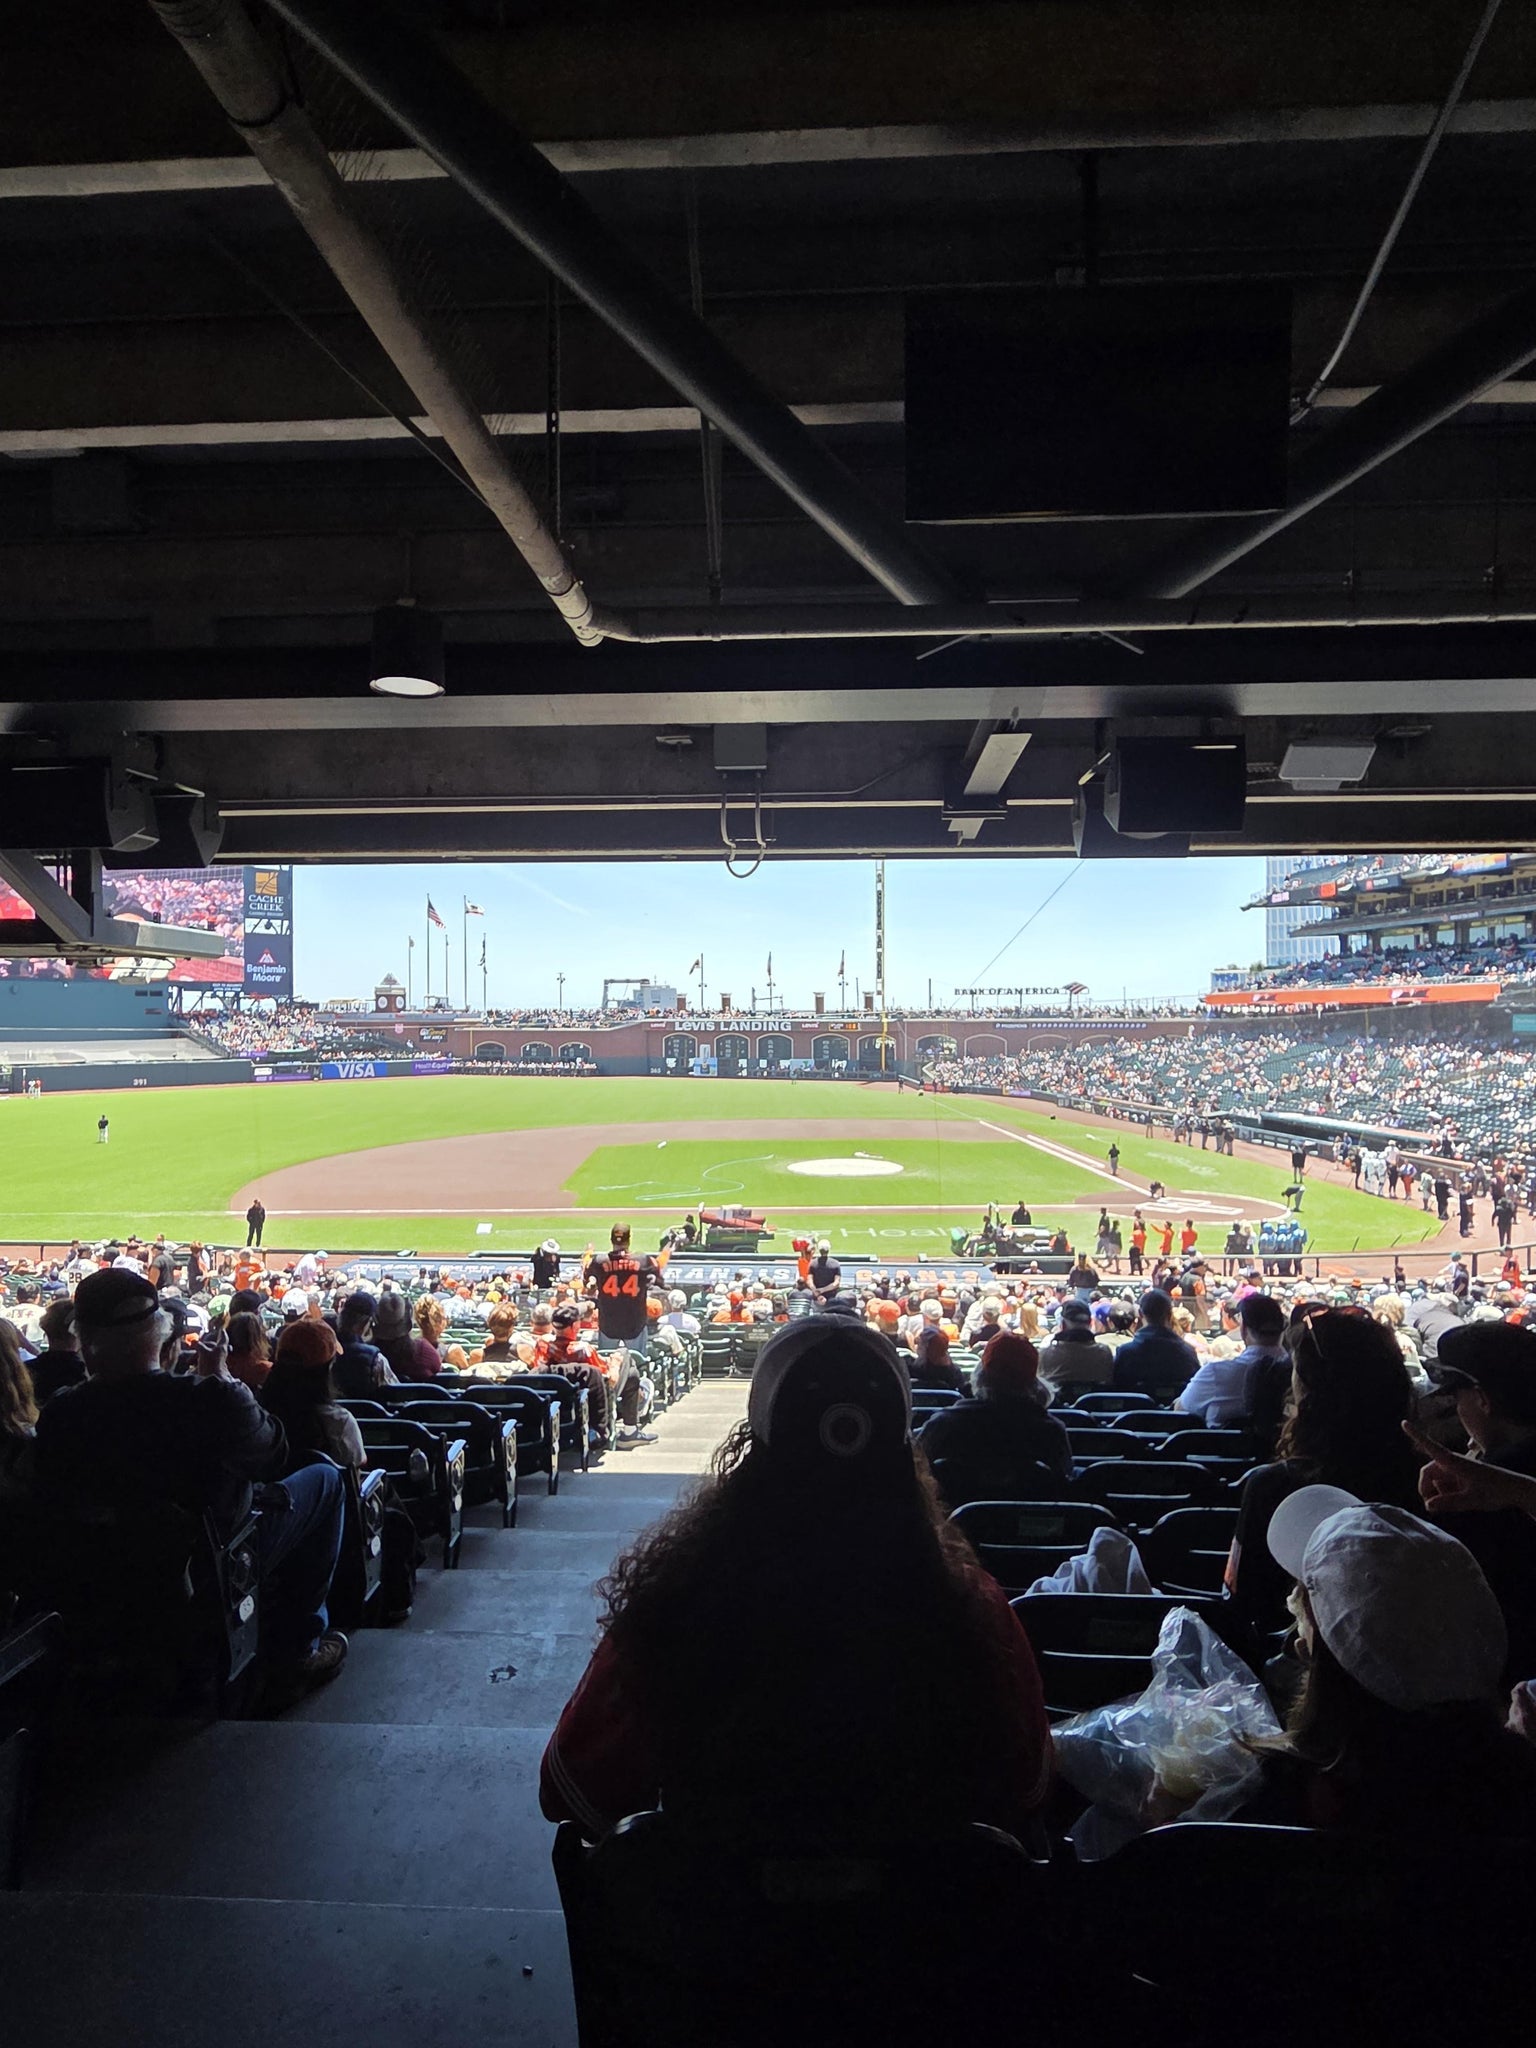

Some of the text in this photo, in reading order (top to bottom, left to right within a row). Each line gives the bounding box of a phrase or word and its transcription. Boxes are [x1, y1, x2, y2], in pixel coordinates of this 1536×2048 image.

[248, 894, 284, 904] CACHE
[249, 902, 283, 912] CREEK
[246, 964, 287, 974] Benjamin
[252, 973, 282, 983] Moore
[1006, 987, 1060, 995] AMERICA
[720, 1020, 792, 1032] LANDING
[335, 1063, 376, 1079] VISA
[133, 1078, 147, 1086] 391
[602, 1274, 640, 1297] 44
